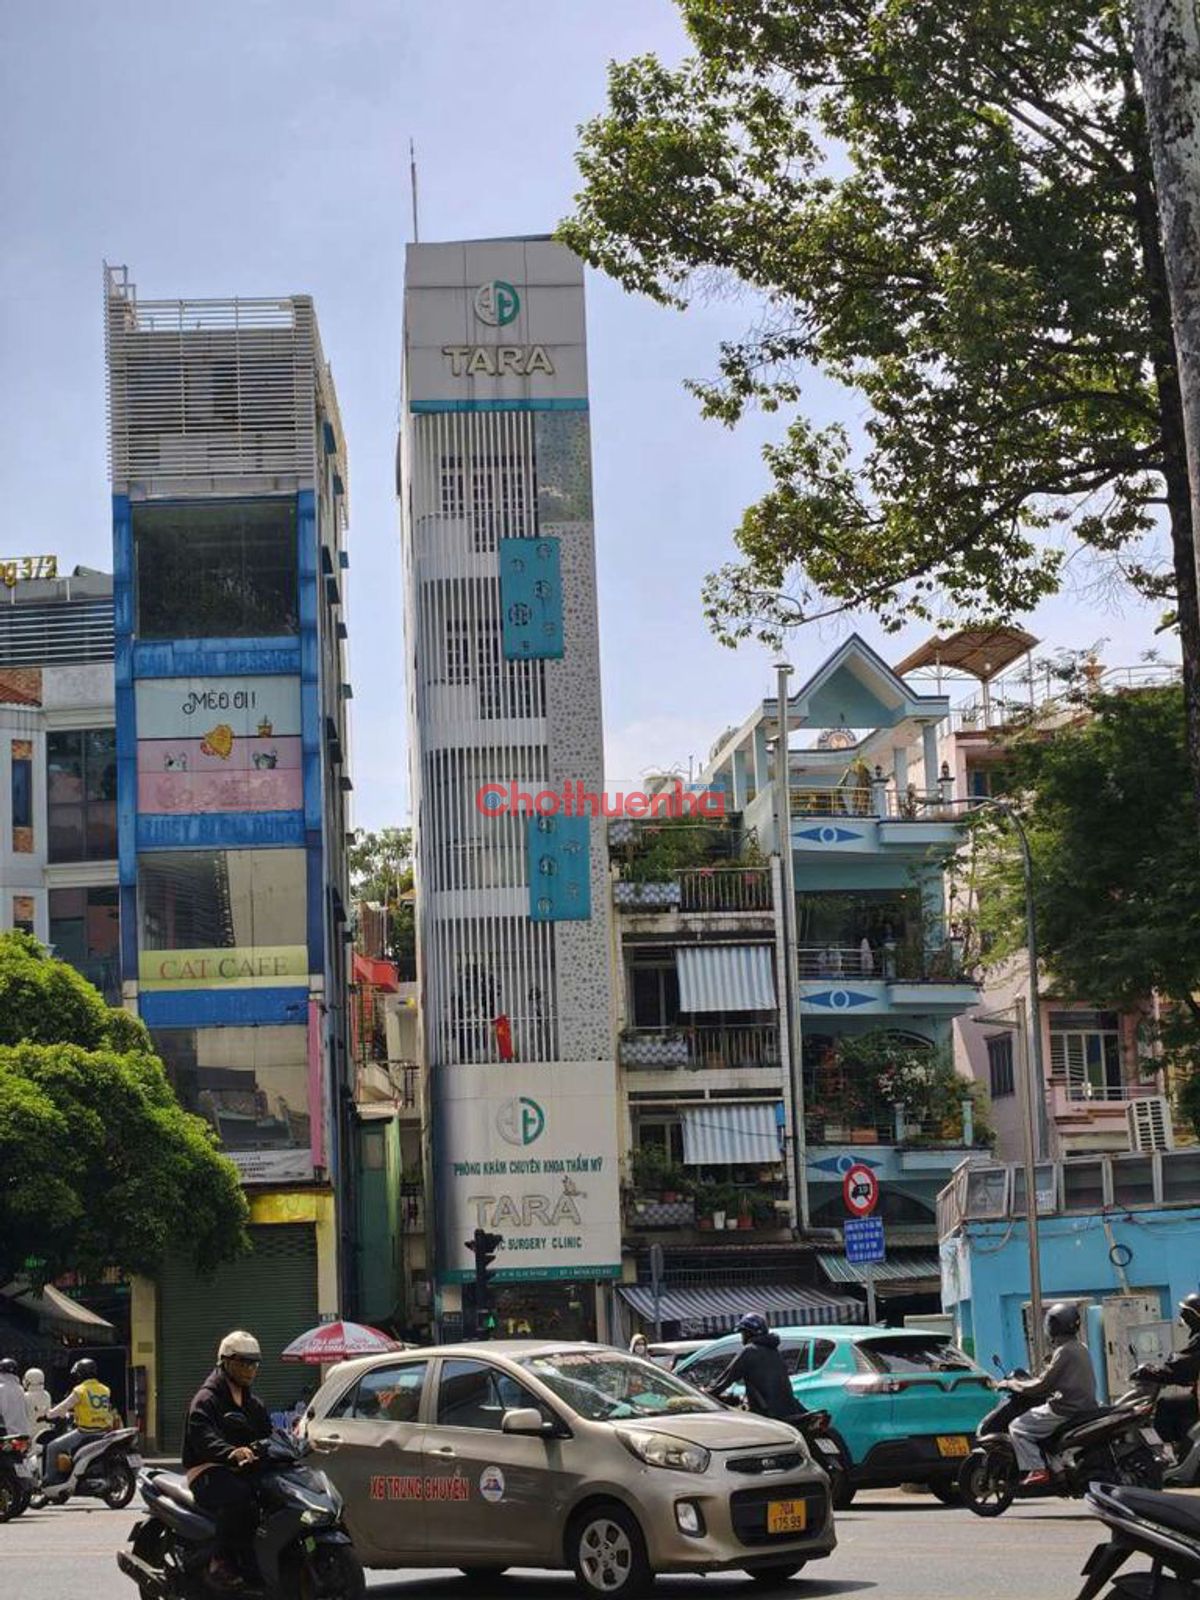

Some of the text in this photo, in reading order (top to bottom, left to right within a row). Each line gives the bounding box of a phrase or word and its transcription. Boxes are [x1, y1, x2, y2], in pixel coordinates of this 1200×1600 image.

[442, 344, 556, 377] TARA
[160, 956, 289, 980] CAT CAFE
[468, 1194, 582, 1227] TARA
[508, 1237, 547, 1250] SURGERY
[551, 1236, 583, 1249] CLINIC
[371, 1476, 385, 1500] XE
[387, 1476, 422, 1500] TRUNG
